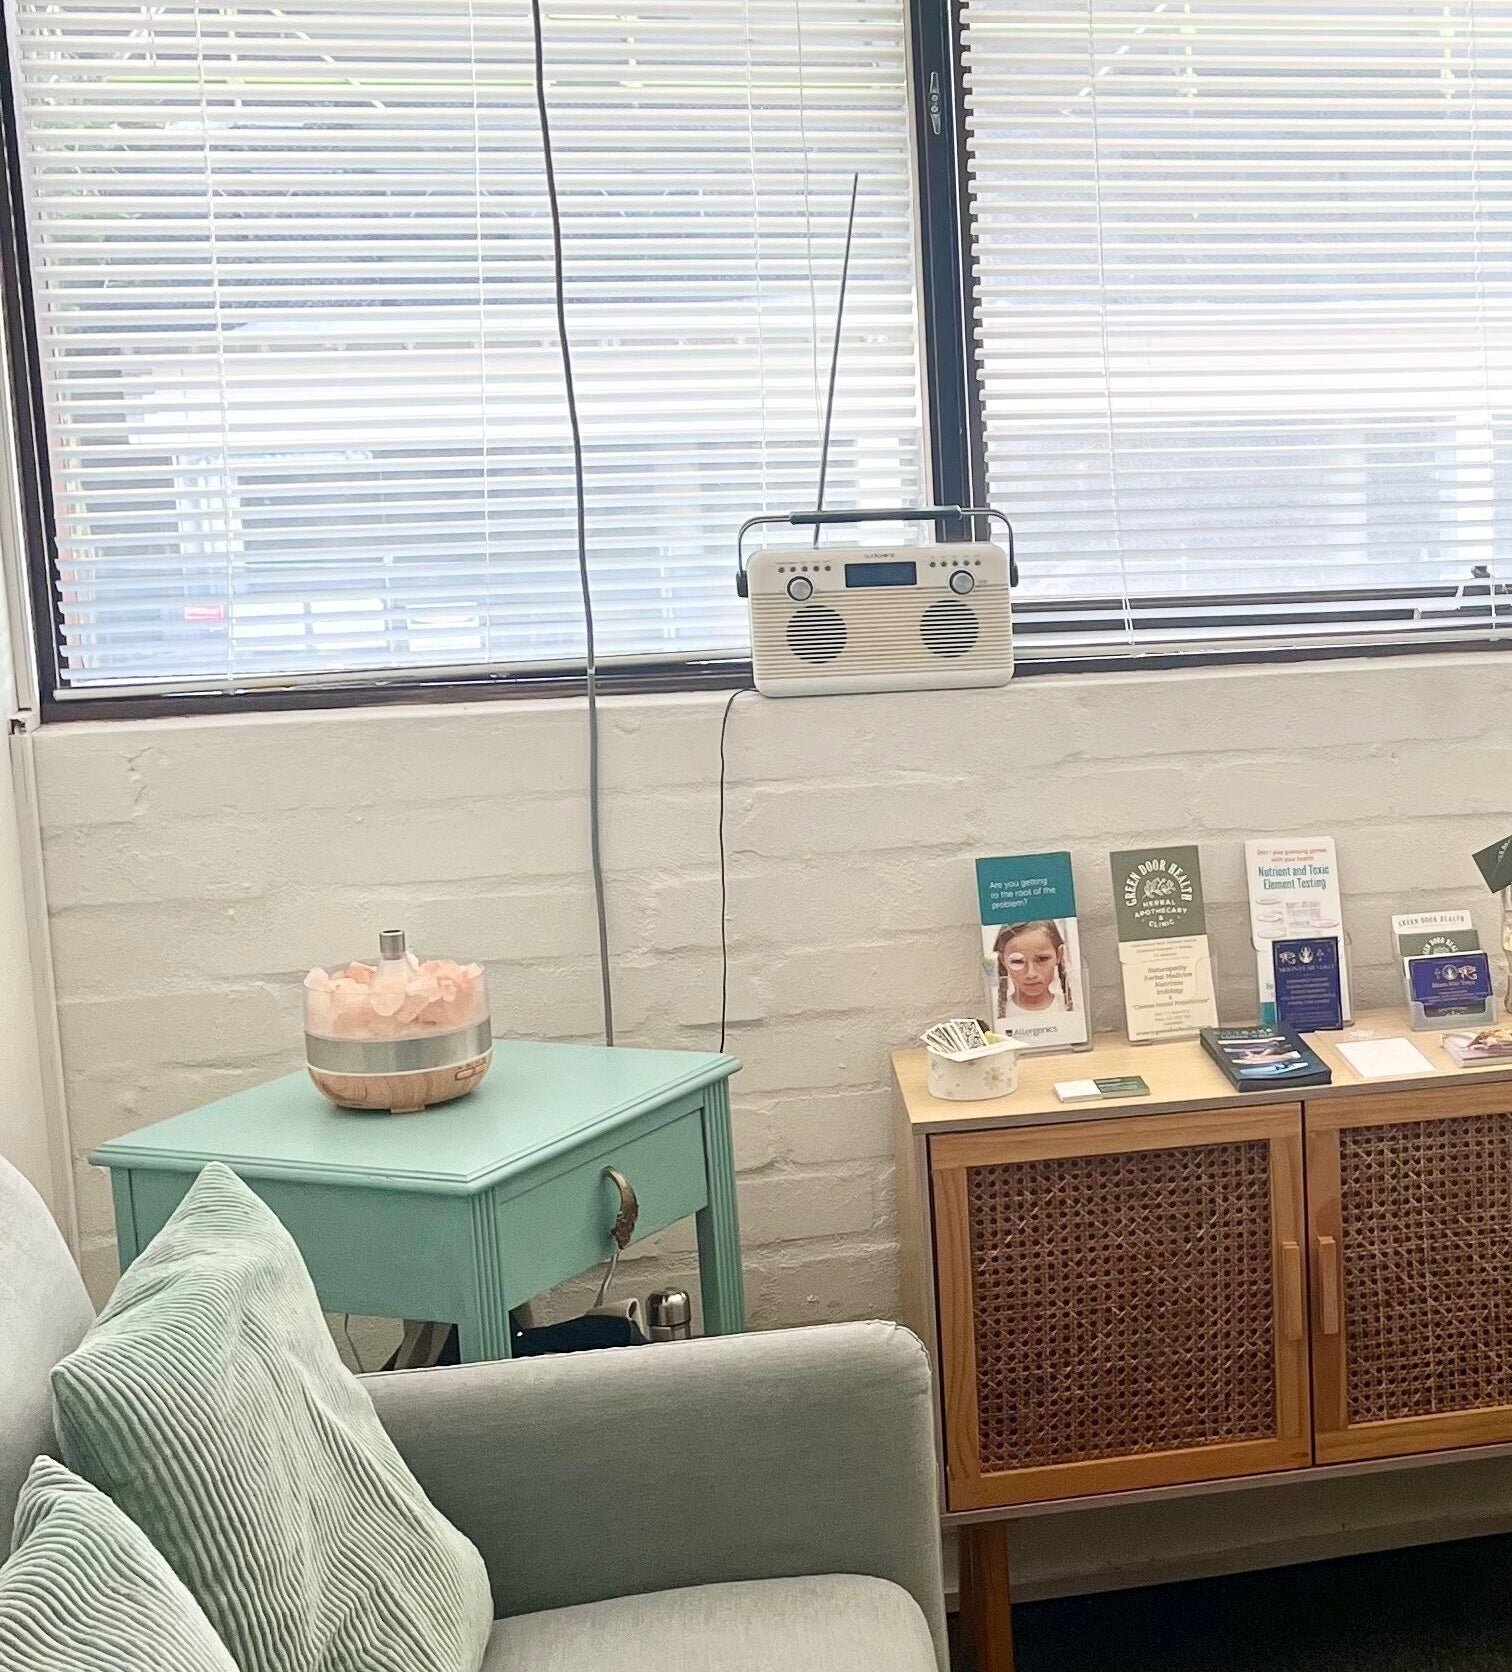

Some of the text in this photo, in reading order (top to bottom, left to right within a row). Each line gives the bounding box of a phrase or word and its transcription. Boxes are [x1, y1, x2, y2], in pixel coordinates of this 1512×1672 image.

[1258, 864, 1330, 877] Nutrient and Toxic
[990, 878, 1048, 890] Are you getting
[1125, 859, 1193, 907] GREEN DOOR HEALTH
[1263, 877, 1327, 890] Element Testing
[1000, 890, 1014, 898] the
[1042, 886, 1056, 895] the
[991, 897, 1028, 910] problem?
[1142, 899, 1176, 907] HERBAL
[1134, 907, 1188, 919] APOTHECARY
[1148, 919, 1175, 928] CLINIC
[1013, 1026, 1058, 1037] Allergenics
